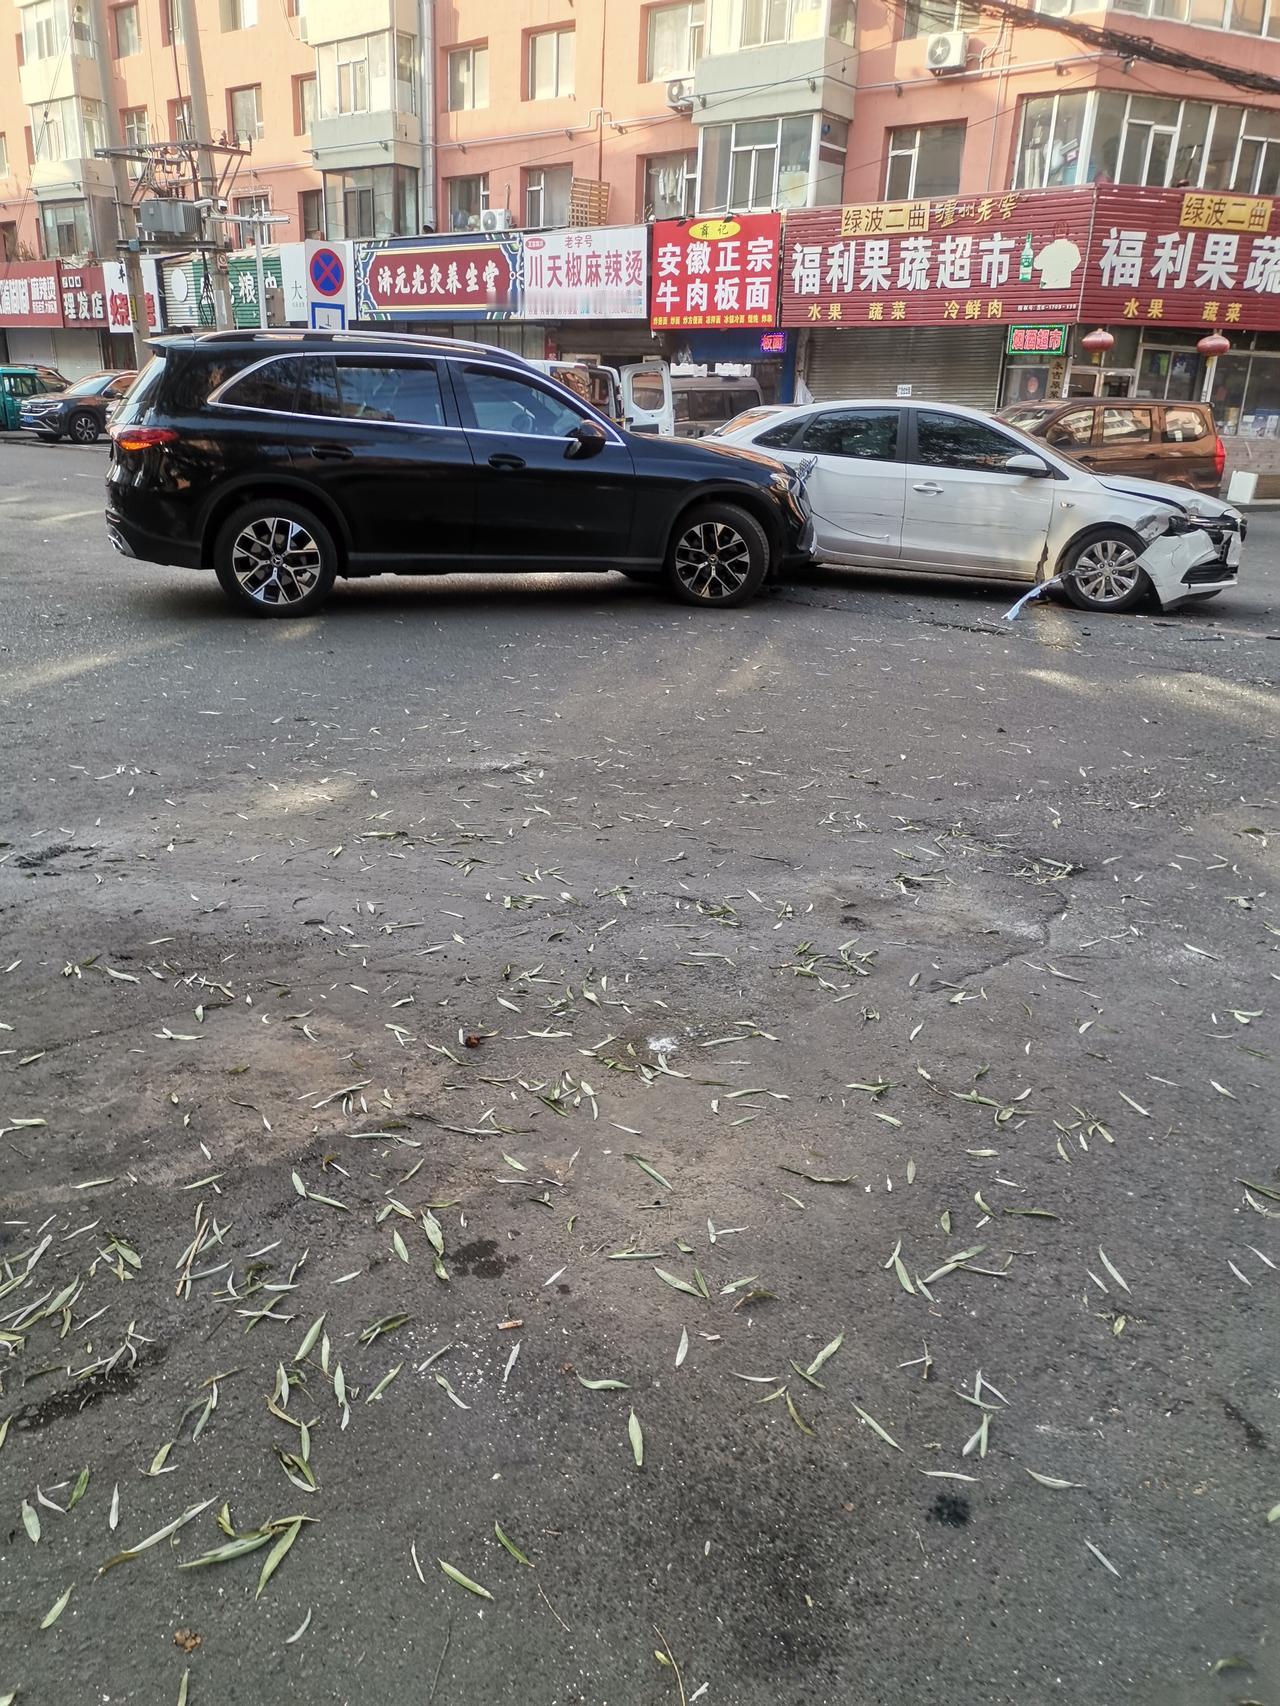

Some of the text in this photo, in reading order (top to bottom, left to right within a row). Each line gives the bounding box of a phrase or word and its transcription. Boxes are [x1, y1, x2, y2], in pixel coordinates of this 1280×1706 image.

[844, 205, 927, 233] 绿波二曲
[1183, 196, 1267, 229] 绿波二曲
[564, 234, 593, 248] 老字号
[656, 236, 774, 277] 安徽正宗
[528, 250, 643, 289] 川天椒麻辣烫
[791, 231, 1016, 295] 福利果蔬超市
[1099, 227, 1280, 294] 福利果蔬
[63, 291, 104, 320] 理发店
[656, 277, 772, 312] 牛肉板面
[807, 299, 1003, 321] 水果 蔬菜 冷鲜肉
[1123, 298, 1242, 323] 水果 蔬菜
[1012, 329, 1062, 350] 烟酒超市
